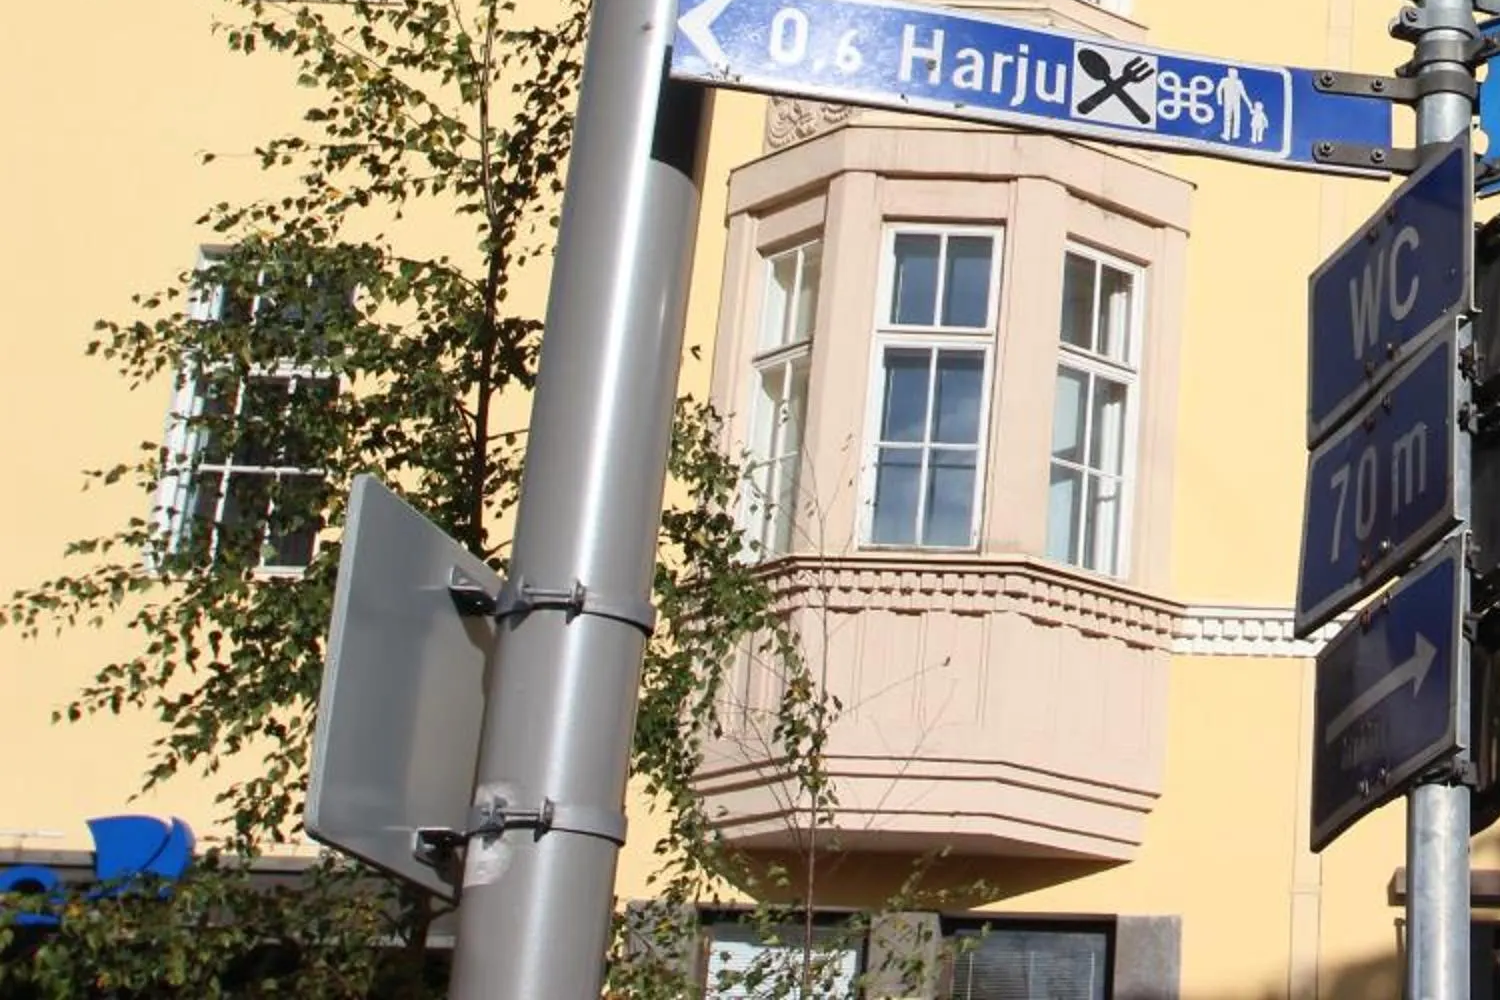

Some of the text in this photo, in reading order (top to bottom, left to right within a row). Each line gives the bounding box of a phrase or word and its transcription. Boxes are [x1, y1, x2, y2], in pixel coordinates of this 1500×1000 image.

[898, 24, 1067, 107] Harju
[1350, 226, 1420, 361] WC
[1330, 420, 1427, 564] 70 m
